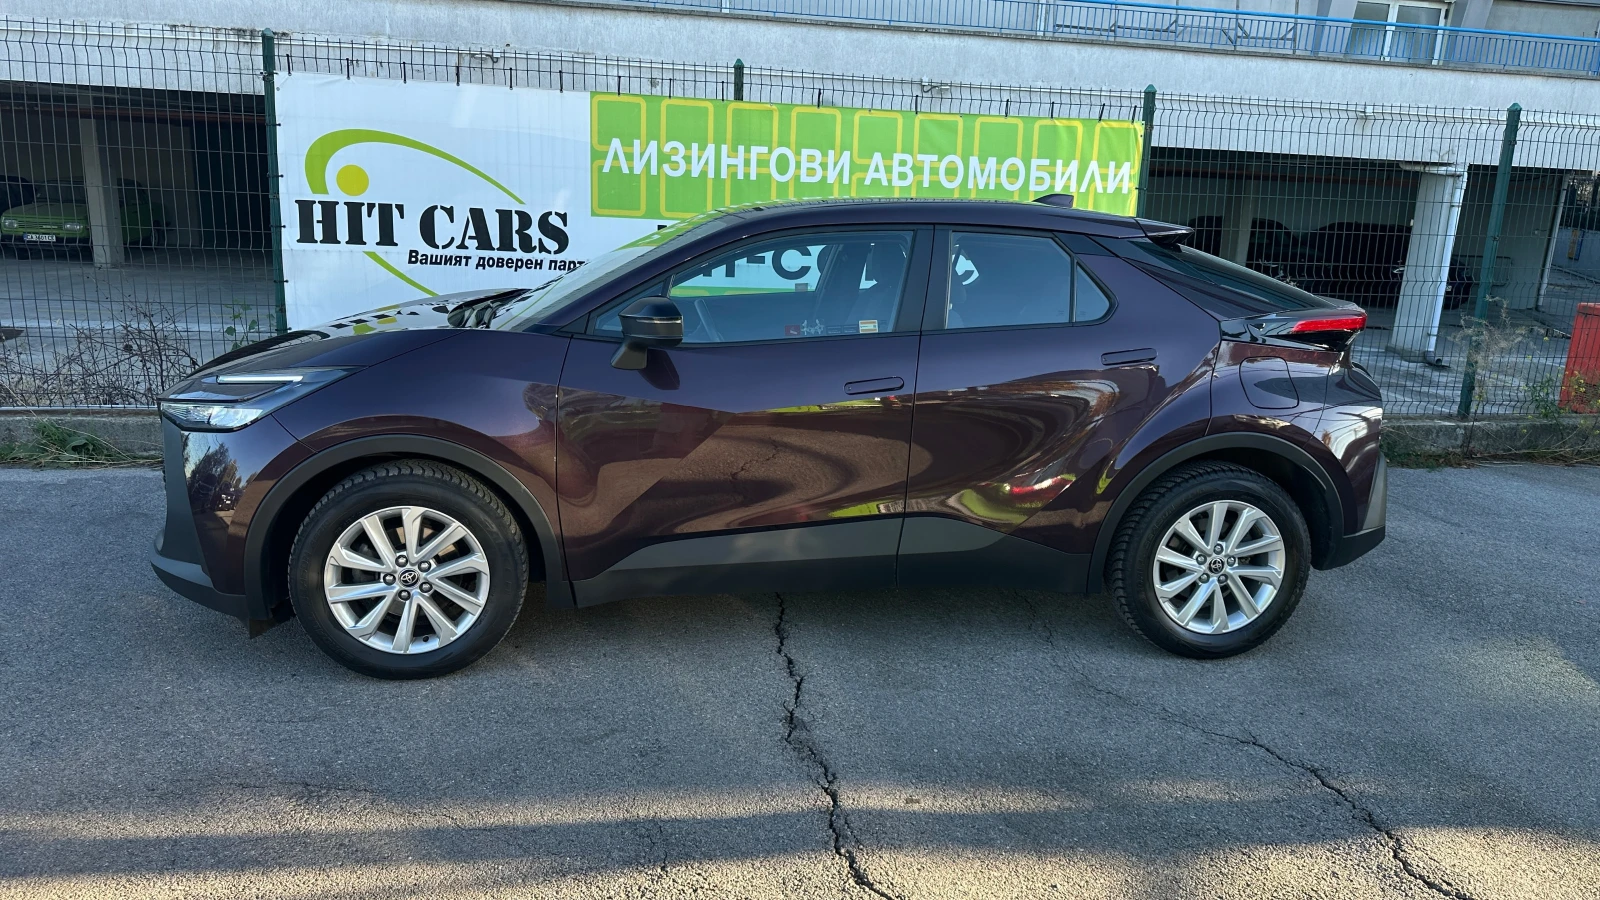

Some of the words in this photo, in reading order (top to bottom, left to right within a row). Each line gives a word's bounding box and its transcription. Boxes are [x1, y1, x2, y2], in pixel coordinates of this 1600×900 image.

[602, 137, 851, 185] ЛИЗИНГОВИ
[863, 151, 1132, 195] АВТОМОБИЛИ
[294, 199, 405, 247] HIT
[418, 204, 570, 256] CARS
[407, 249, 472, 268] Вашият
[475, 253, 544, 272] доверен
